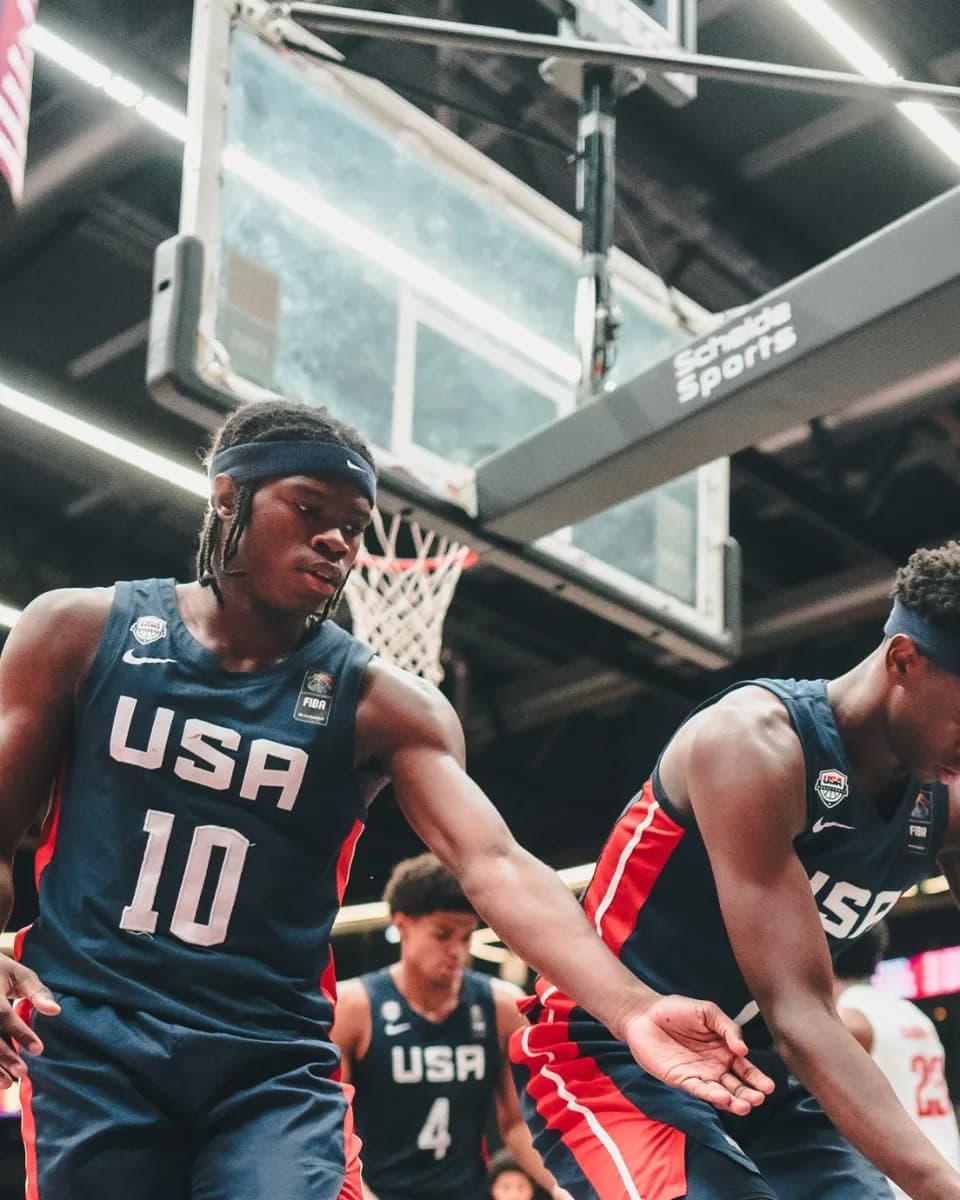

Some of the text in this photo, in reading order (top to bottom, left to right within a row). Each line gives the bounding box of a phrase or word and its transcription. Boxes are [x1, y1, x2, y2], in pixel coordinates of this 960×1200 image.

[676, 326, 797, 403] Sports
[303, 697, 326, 710] FIBA
[109, 695, 309, 811] USA
[119, 808, 250, 947] 10
[809, 869, 902, 939] SA
[391, 1045, 486, 1084] USA
[417, 1097, 452, 1160] 4
